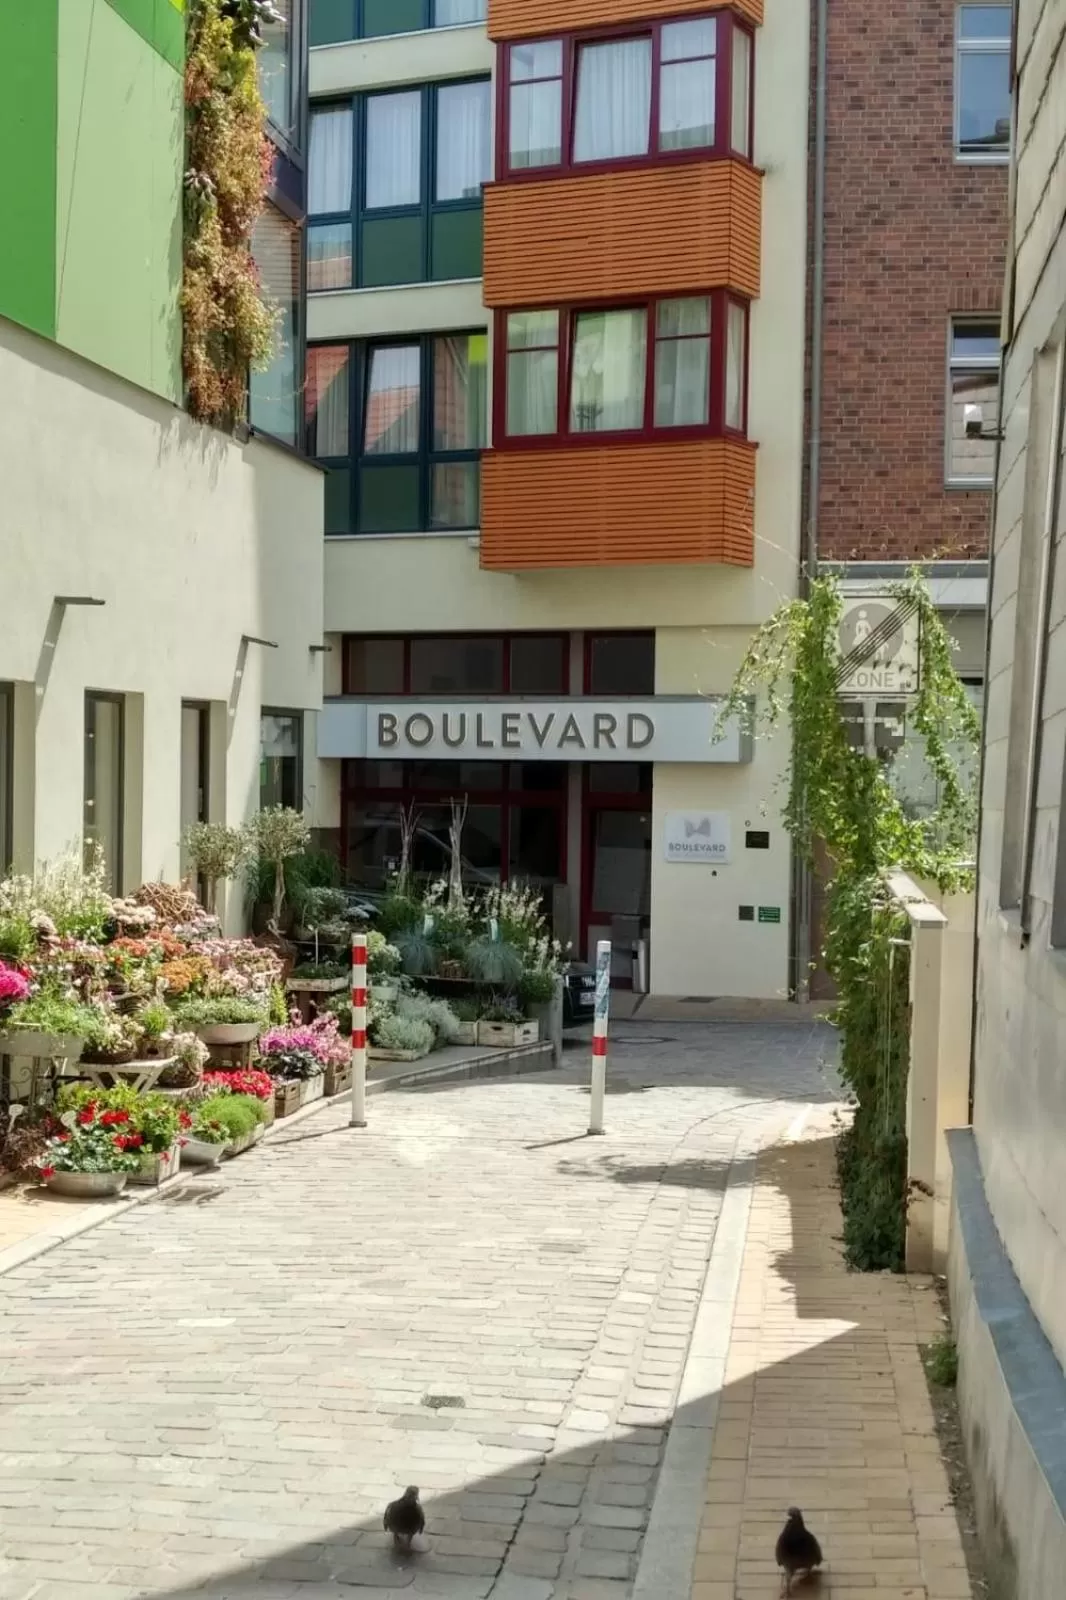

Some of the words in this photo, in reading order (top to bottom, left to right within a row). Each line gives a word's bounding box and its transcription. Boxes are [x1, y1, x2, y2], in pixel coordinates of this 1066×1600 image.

[845, 672, 895, 688] ZONE
[378, 712, 655, 750] BOULEVARD
[668, 842, 726, 852] BOULEVARD
